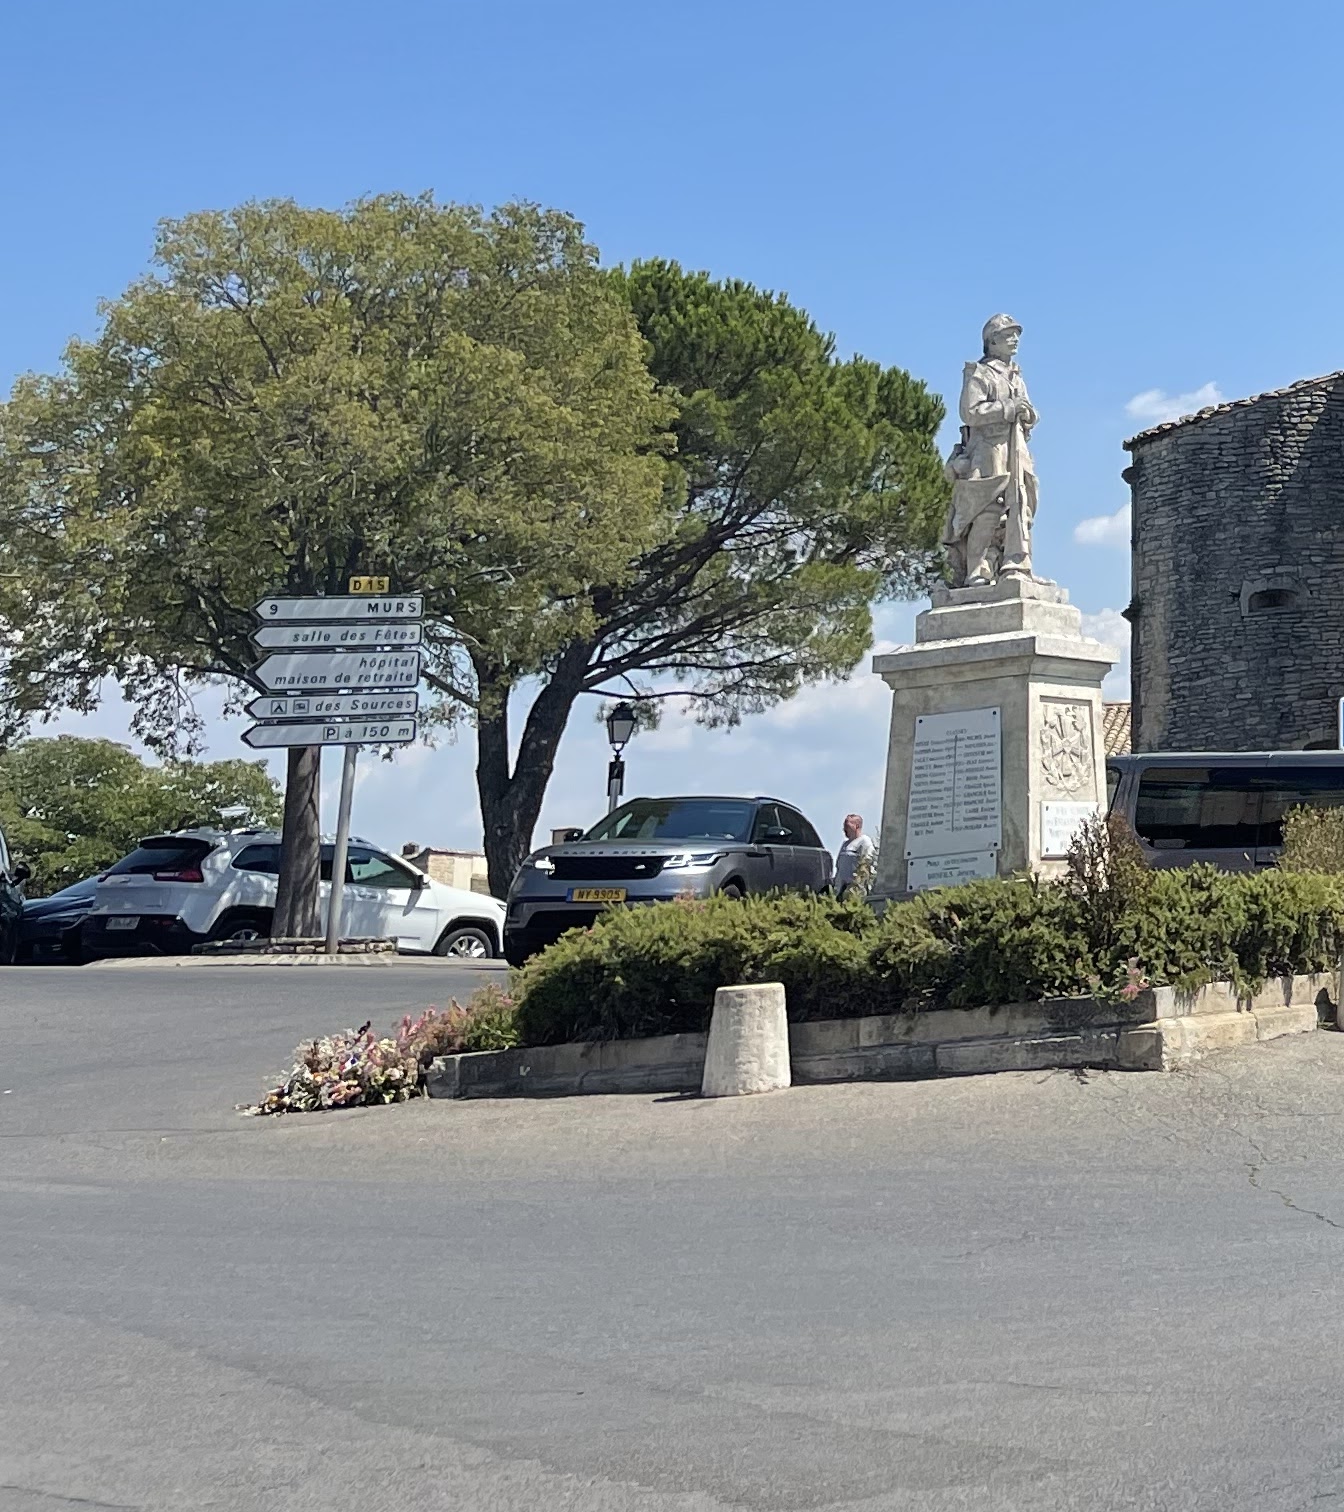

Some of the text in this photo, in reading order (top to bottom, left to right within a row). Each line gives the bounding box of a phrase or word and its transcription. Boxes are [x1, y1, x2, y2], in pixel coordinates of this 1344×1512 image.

[353, 580, 362, 591] D
[269, 602, 417, 615] 9 MURS
[292, 630, 331, 642] salle
[340, 630, 366, 641] des
[359, 656, 415, 670] hôpital
[274, 671, 413, 685] maison de retraite
[315, 699, 412, 712] des Sources
[326, 728, 336, 739] P
[361, 725, 390, 738] 150
[397, 727, 410, 736] m
